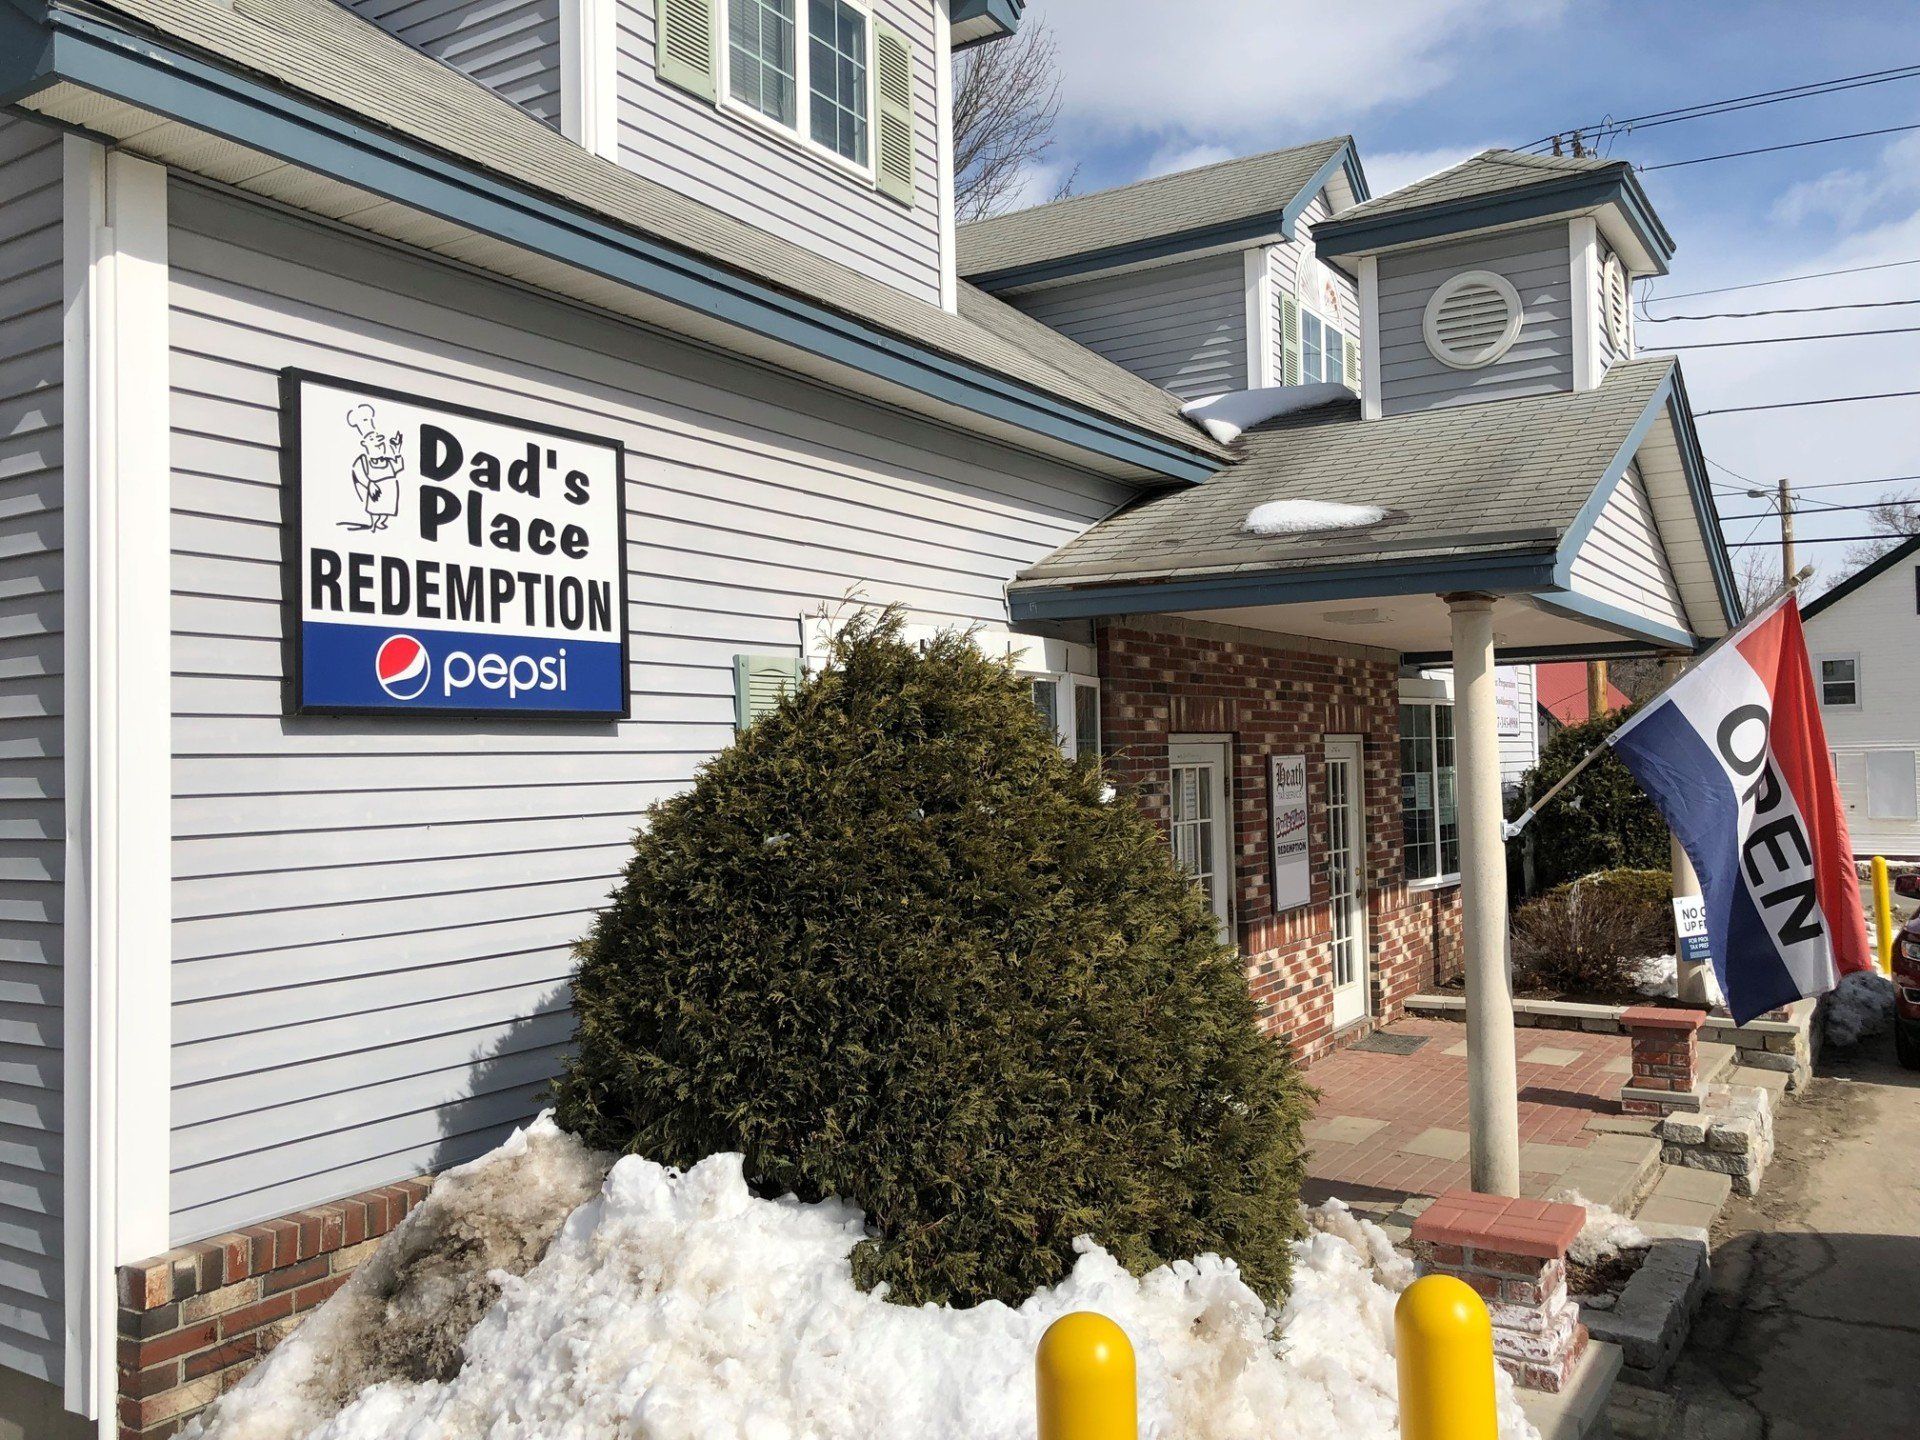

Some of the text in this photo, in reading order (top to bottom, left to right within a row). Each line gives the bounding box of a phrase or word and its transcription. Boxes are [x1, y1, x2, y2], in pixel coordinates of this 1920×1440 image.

[420, 423, 591, 506] Dad's
[420, 485, 590, 559] Place
[310, 547, 612, 632] REDEMPTION
[444, 648, 567, 699] pepsi
[1276, 762, 1304, 791] Heath
[1277, 841, 1306, 855] REDEMPTION
[1716, 703, 1824, 947] OPEN
[1682, 908, 1698, 919] NO
[1684, 921, 1696, 931] UP
